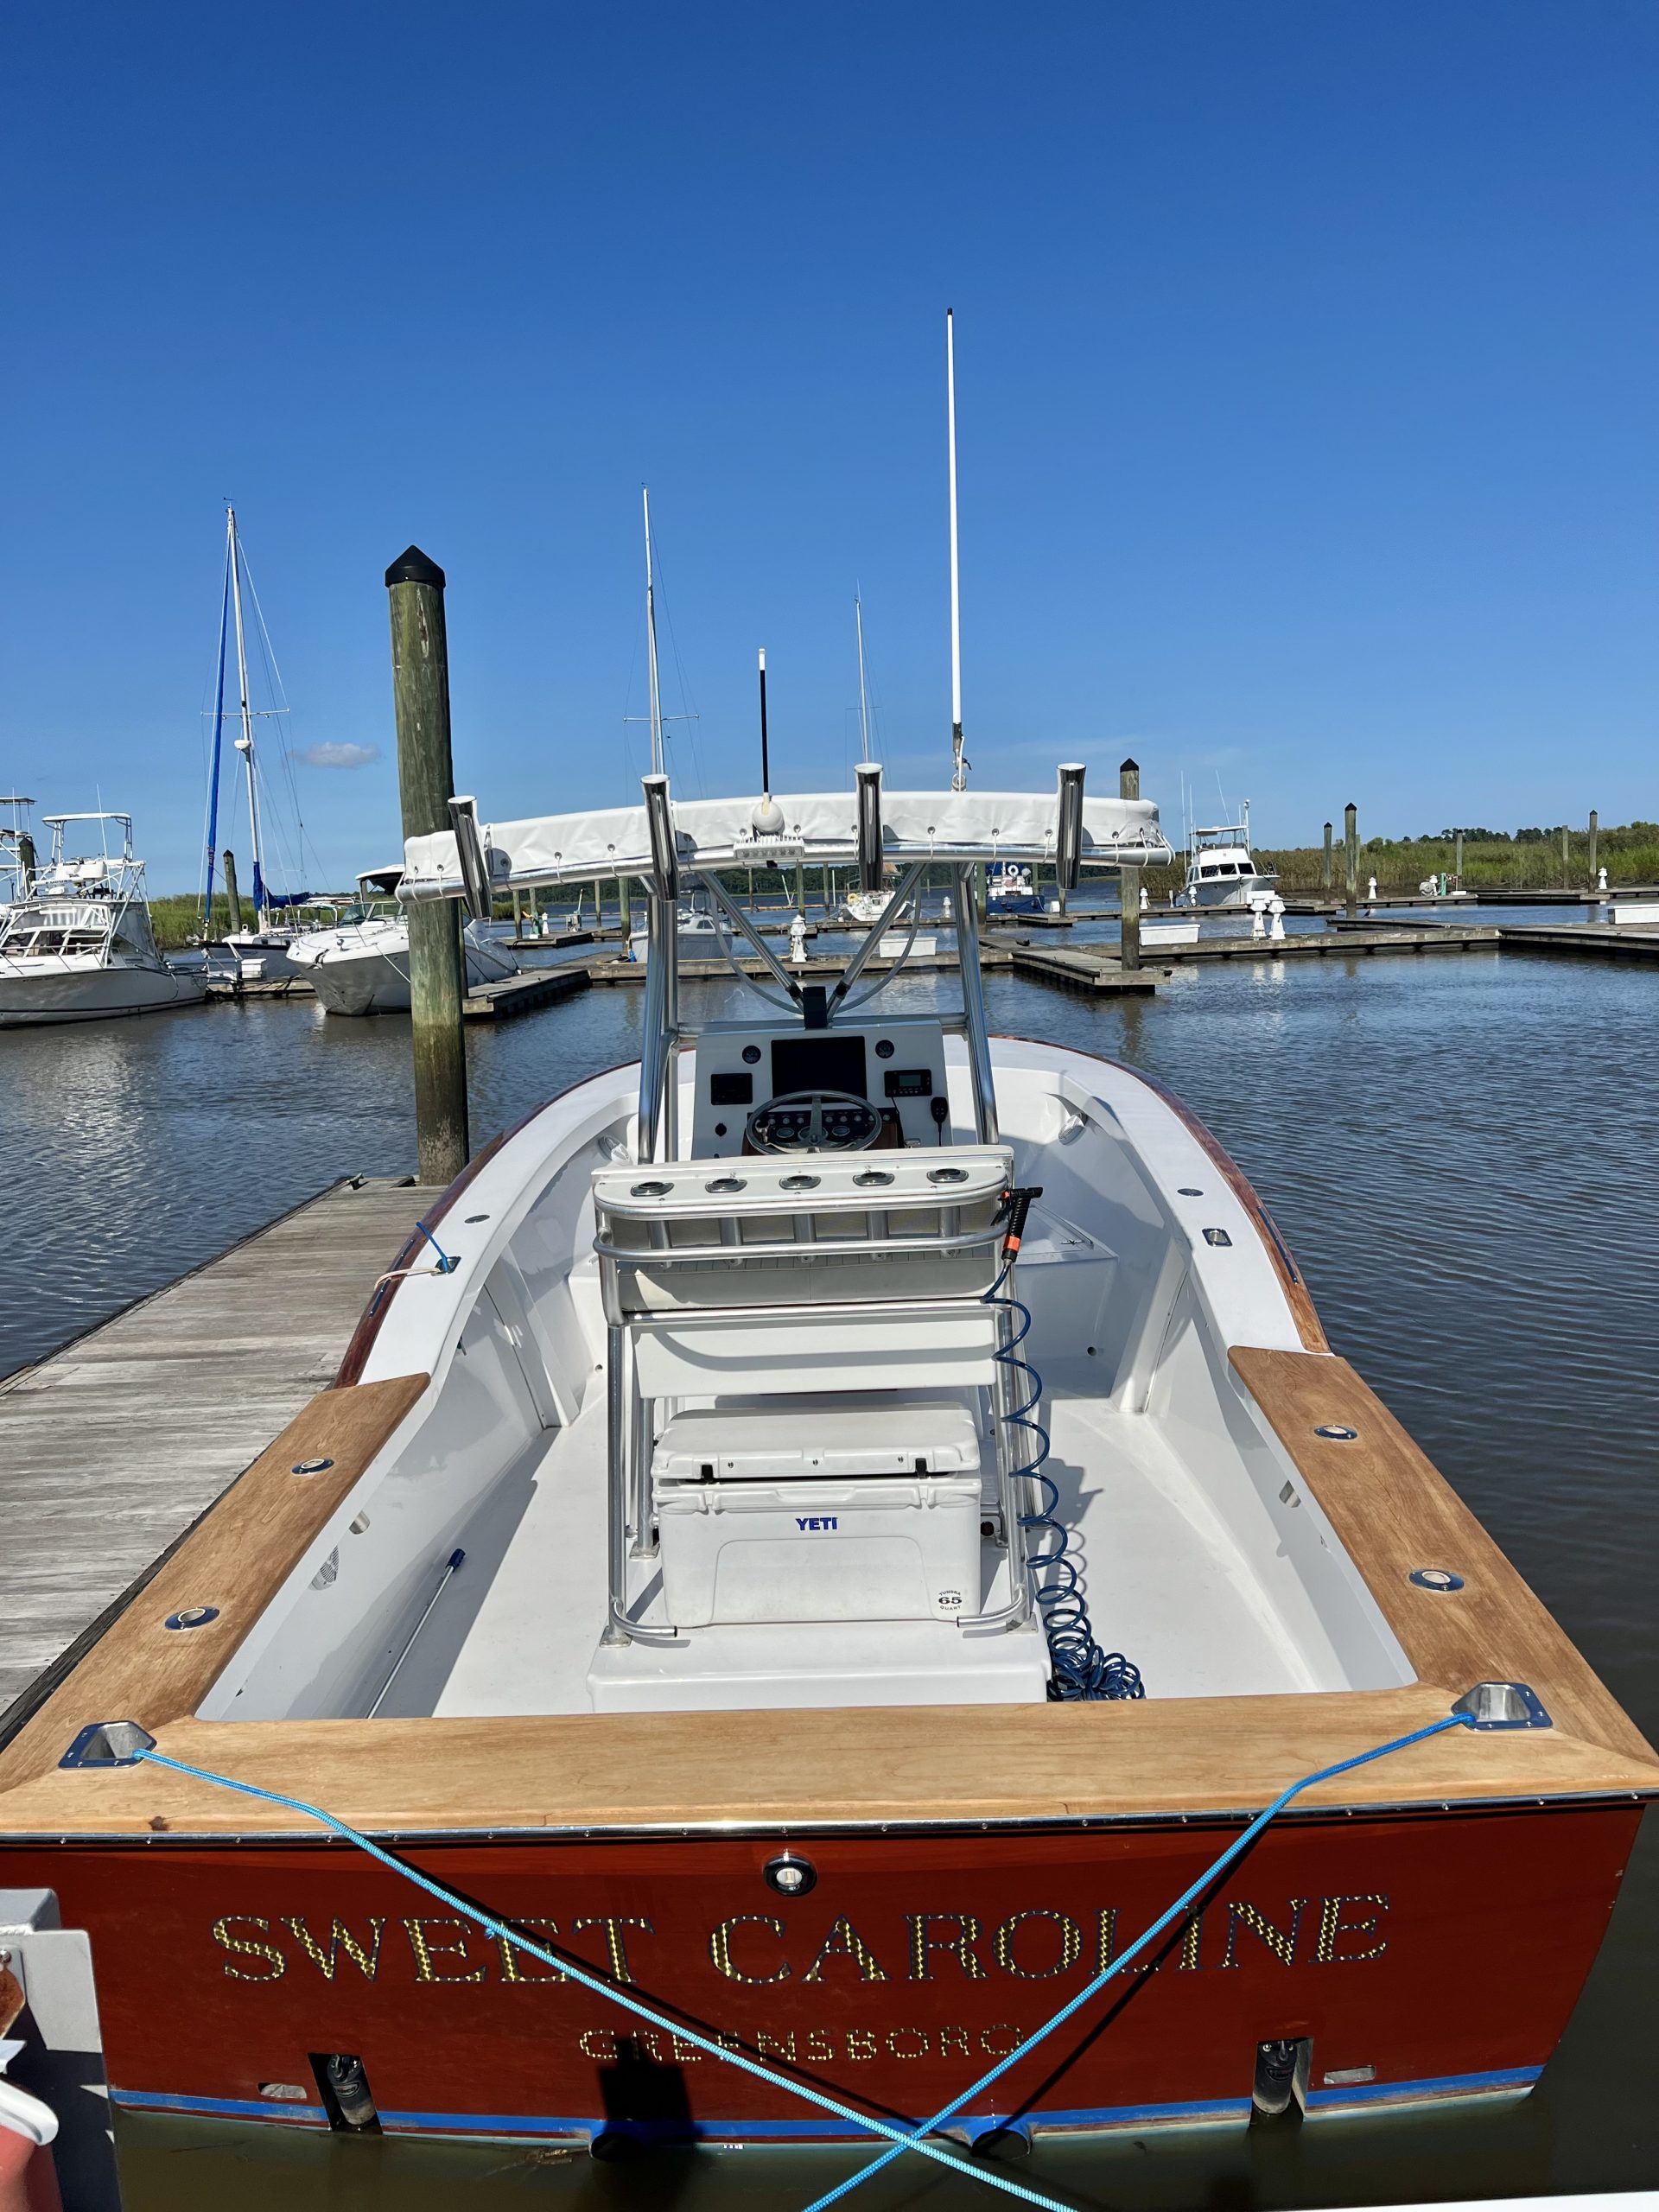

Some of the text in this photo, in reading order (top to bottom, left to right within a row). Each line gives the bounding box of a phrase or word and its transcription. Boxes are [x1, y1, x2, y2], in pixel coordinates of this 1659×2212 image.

[795, 1516, 838, 1530] YETI
[938, 1596, 963, 1605] 65
[212, 1893, 1389, 1985] SWEET CAROLINE
